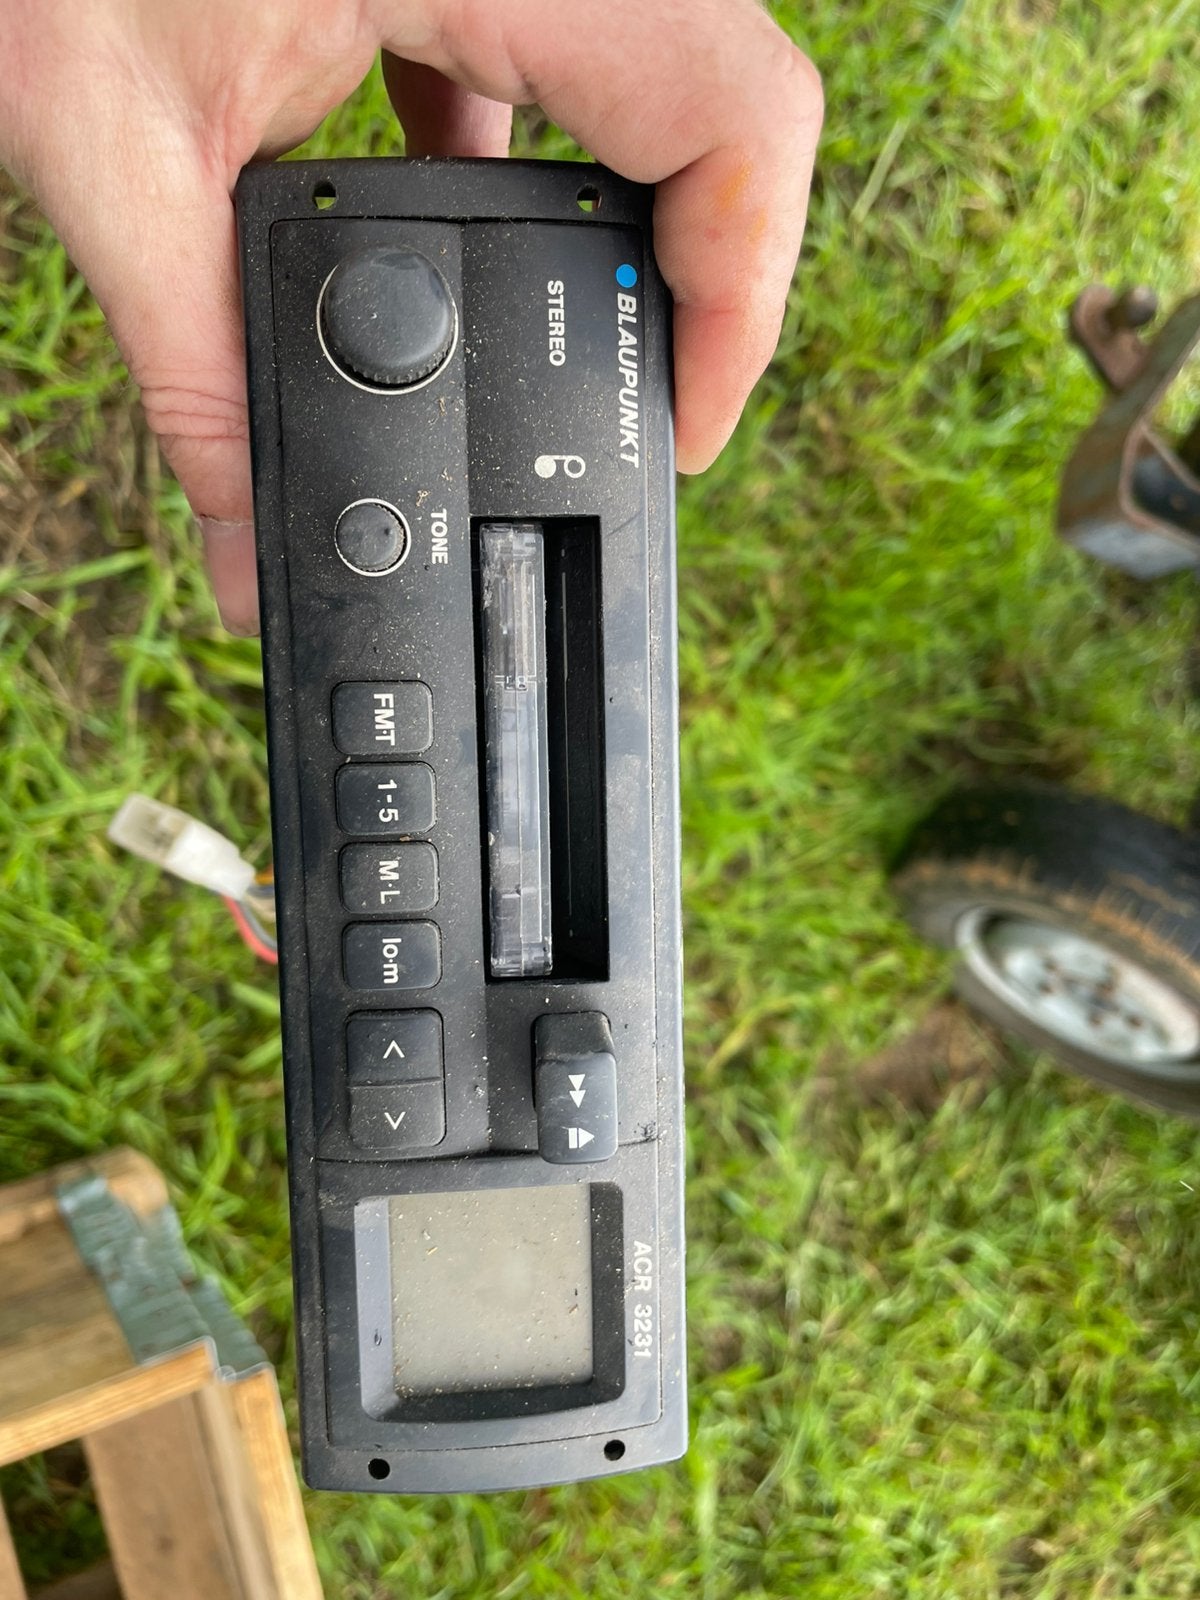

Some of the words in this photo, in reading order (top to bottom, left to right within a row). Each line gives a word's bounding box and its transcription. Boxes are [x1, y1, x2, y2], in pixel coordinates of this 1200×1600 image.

[547, 280, 566, 367] STEREO
[616, 292, 640, 469] BLAUPUNKT
[430, 508, 449, 565] TONE
[377, 779, 399, 823] 1-5
[633, 1240, 653, 1292] ACR
[633, 1303, 653, 1358] 3231
